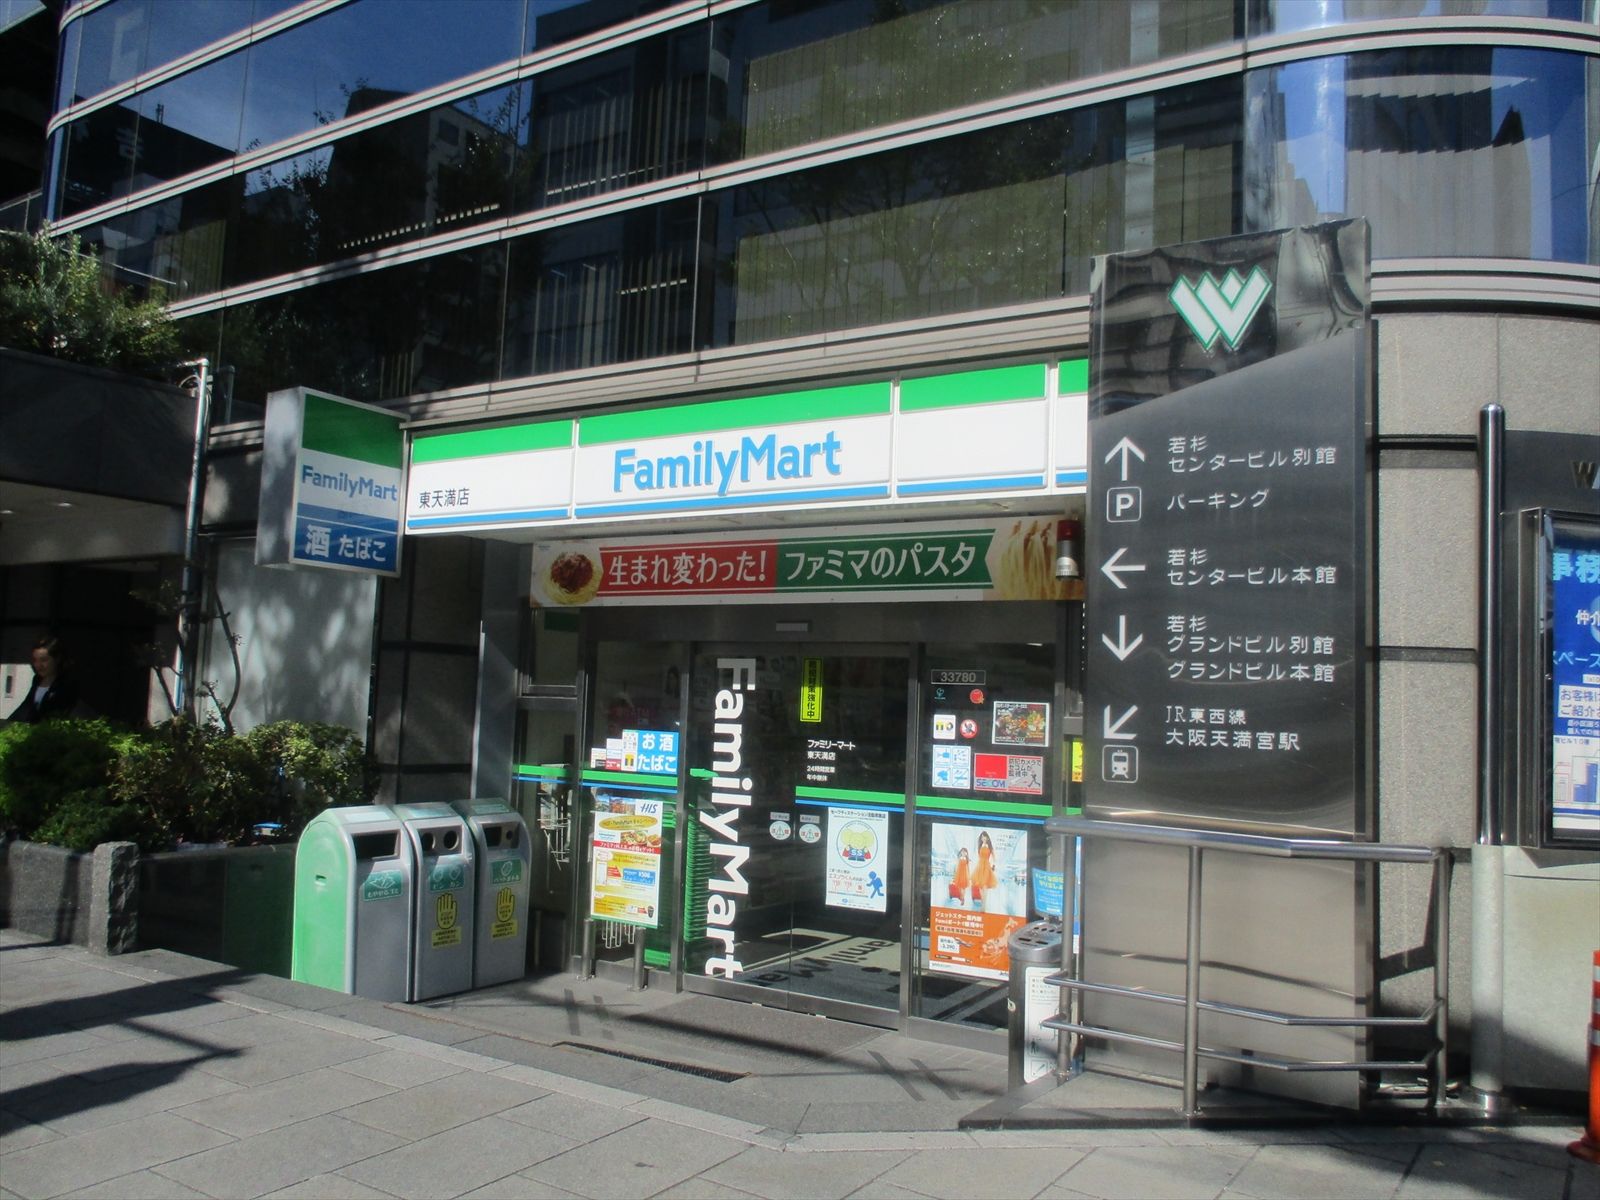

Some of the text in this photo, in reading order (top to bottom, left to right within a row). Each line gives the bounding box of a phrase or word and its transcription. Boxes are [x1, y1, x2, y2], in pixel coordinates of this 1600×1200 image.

[1167, 435, 1208, 453] 若杉
[613, 431, 841, 496] FamilyMart
[1167, 446, 1337, 473] センタービル別館
[302, 465, 398, 502] FamilyMart
[419, 487, 470, 509] 東天満店
[1166, 488, 1270, 511] パーキング
[305, 523, 387, 563] 酒 たばこ
[608, 541, 976, 587] 生まれ変わった! ファミマのパスタ
[1167, 548, 1208, 566] 若杉
[1167, 565, 1337, 586] センタービル本館
[1166, 615, 1208, 632] 若杉
[1166, 635, 1335, 656] グランドビル別館
[940, 672, 977, 683] 33780
[1166, 661, 1335, 683] グランドビル本館
[1165, 705, 1247, 725] JR東西線
[642, 733, 674, 752] お酒
[807, 739, 856, 751] ファミリーマート
[1166, 728, 1301, 751] 大阪天満宮駅
[638, 753, 677, 772] たばこ
[807, 751, 836, 761] 東天満店
[976, 778, 1006, 788] SEOM
[699, 657, 757, 979] FamilyMart
